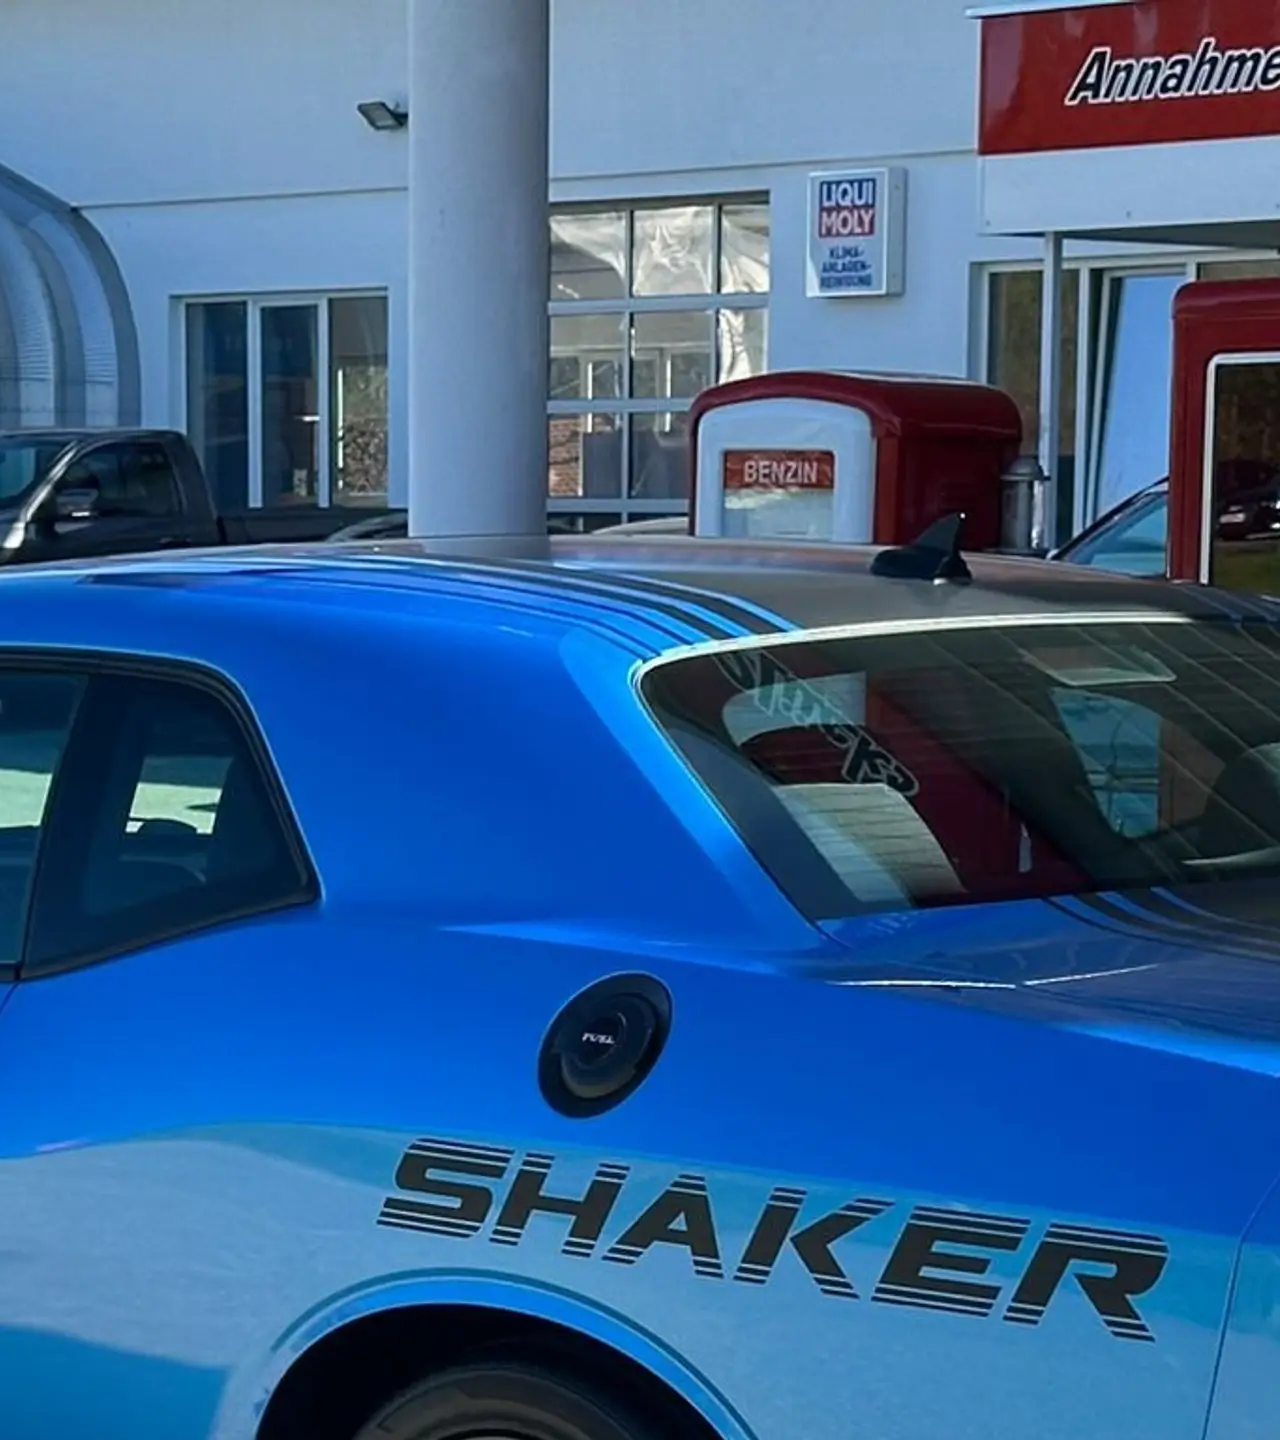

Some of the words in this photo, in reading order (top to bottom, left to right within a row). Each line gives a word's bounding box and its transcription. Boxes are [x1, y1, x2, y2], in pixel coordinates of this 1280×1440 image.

[822, 180, 875, 206] LIQUI
[821, 208, 874, 236] MOLY
[743, 459, 818, 484] BENZIN
[376, 1136, 1170, 1343] SHAKER
